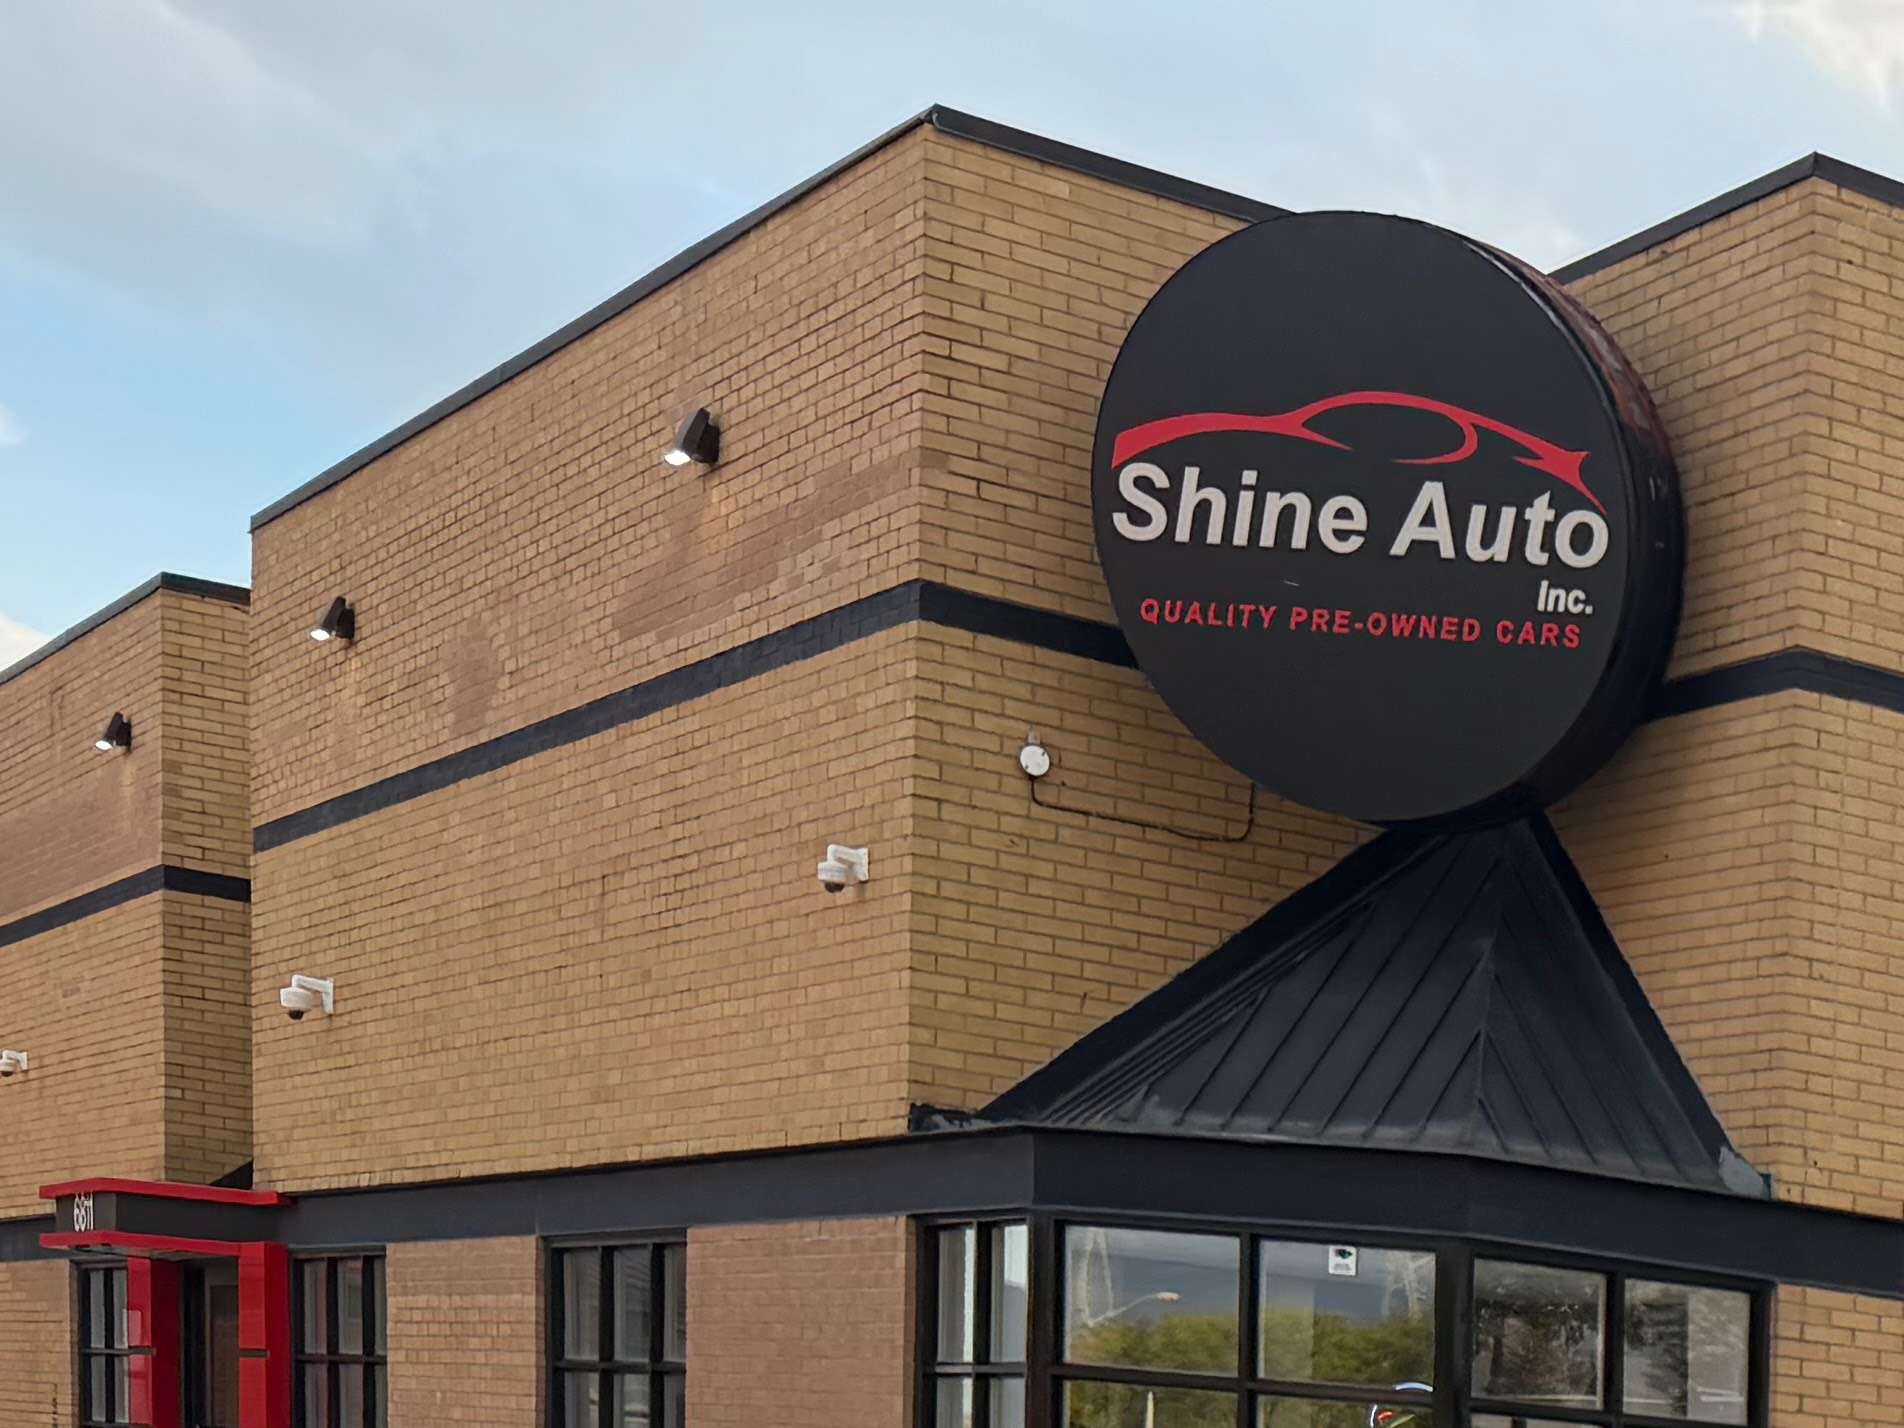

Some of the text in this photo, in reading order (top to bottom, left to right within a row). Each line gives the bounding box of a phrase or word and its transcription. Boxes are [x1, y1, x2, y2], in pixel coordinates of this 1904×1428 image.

[1112, 462, 1609, 569] Shine Auto
[1536, 580, 1593, 615] Inc.
[1140, 598, 1581, 649] QUALITY PRE-OWNED CARS
